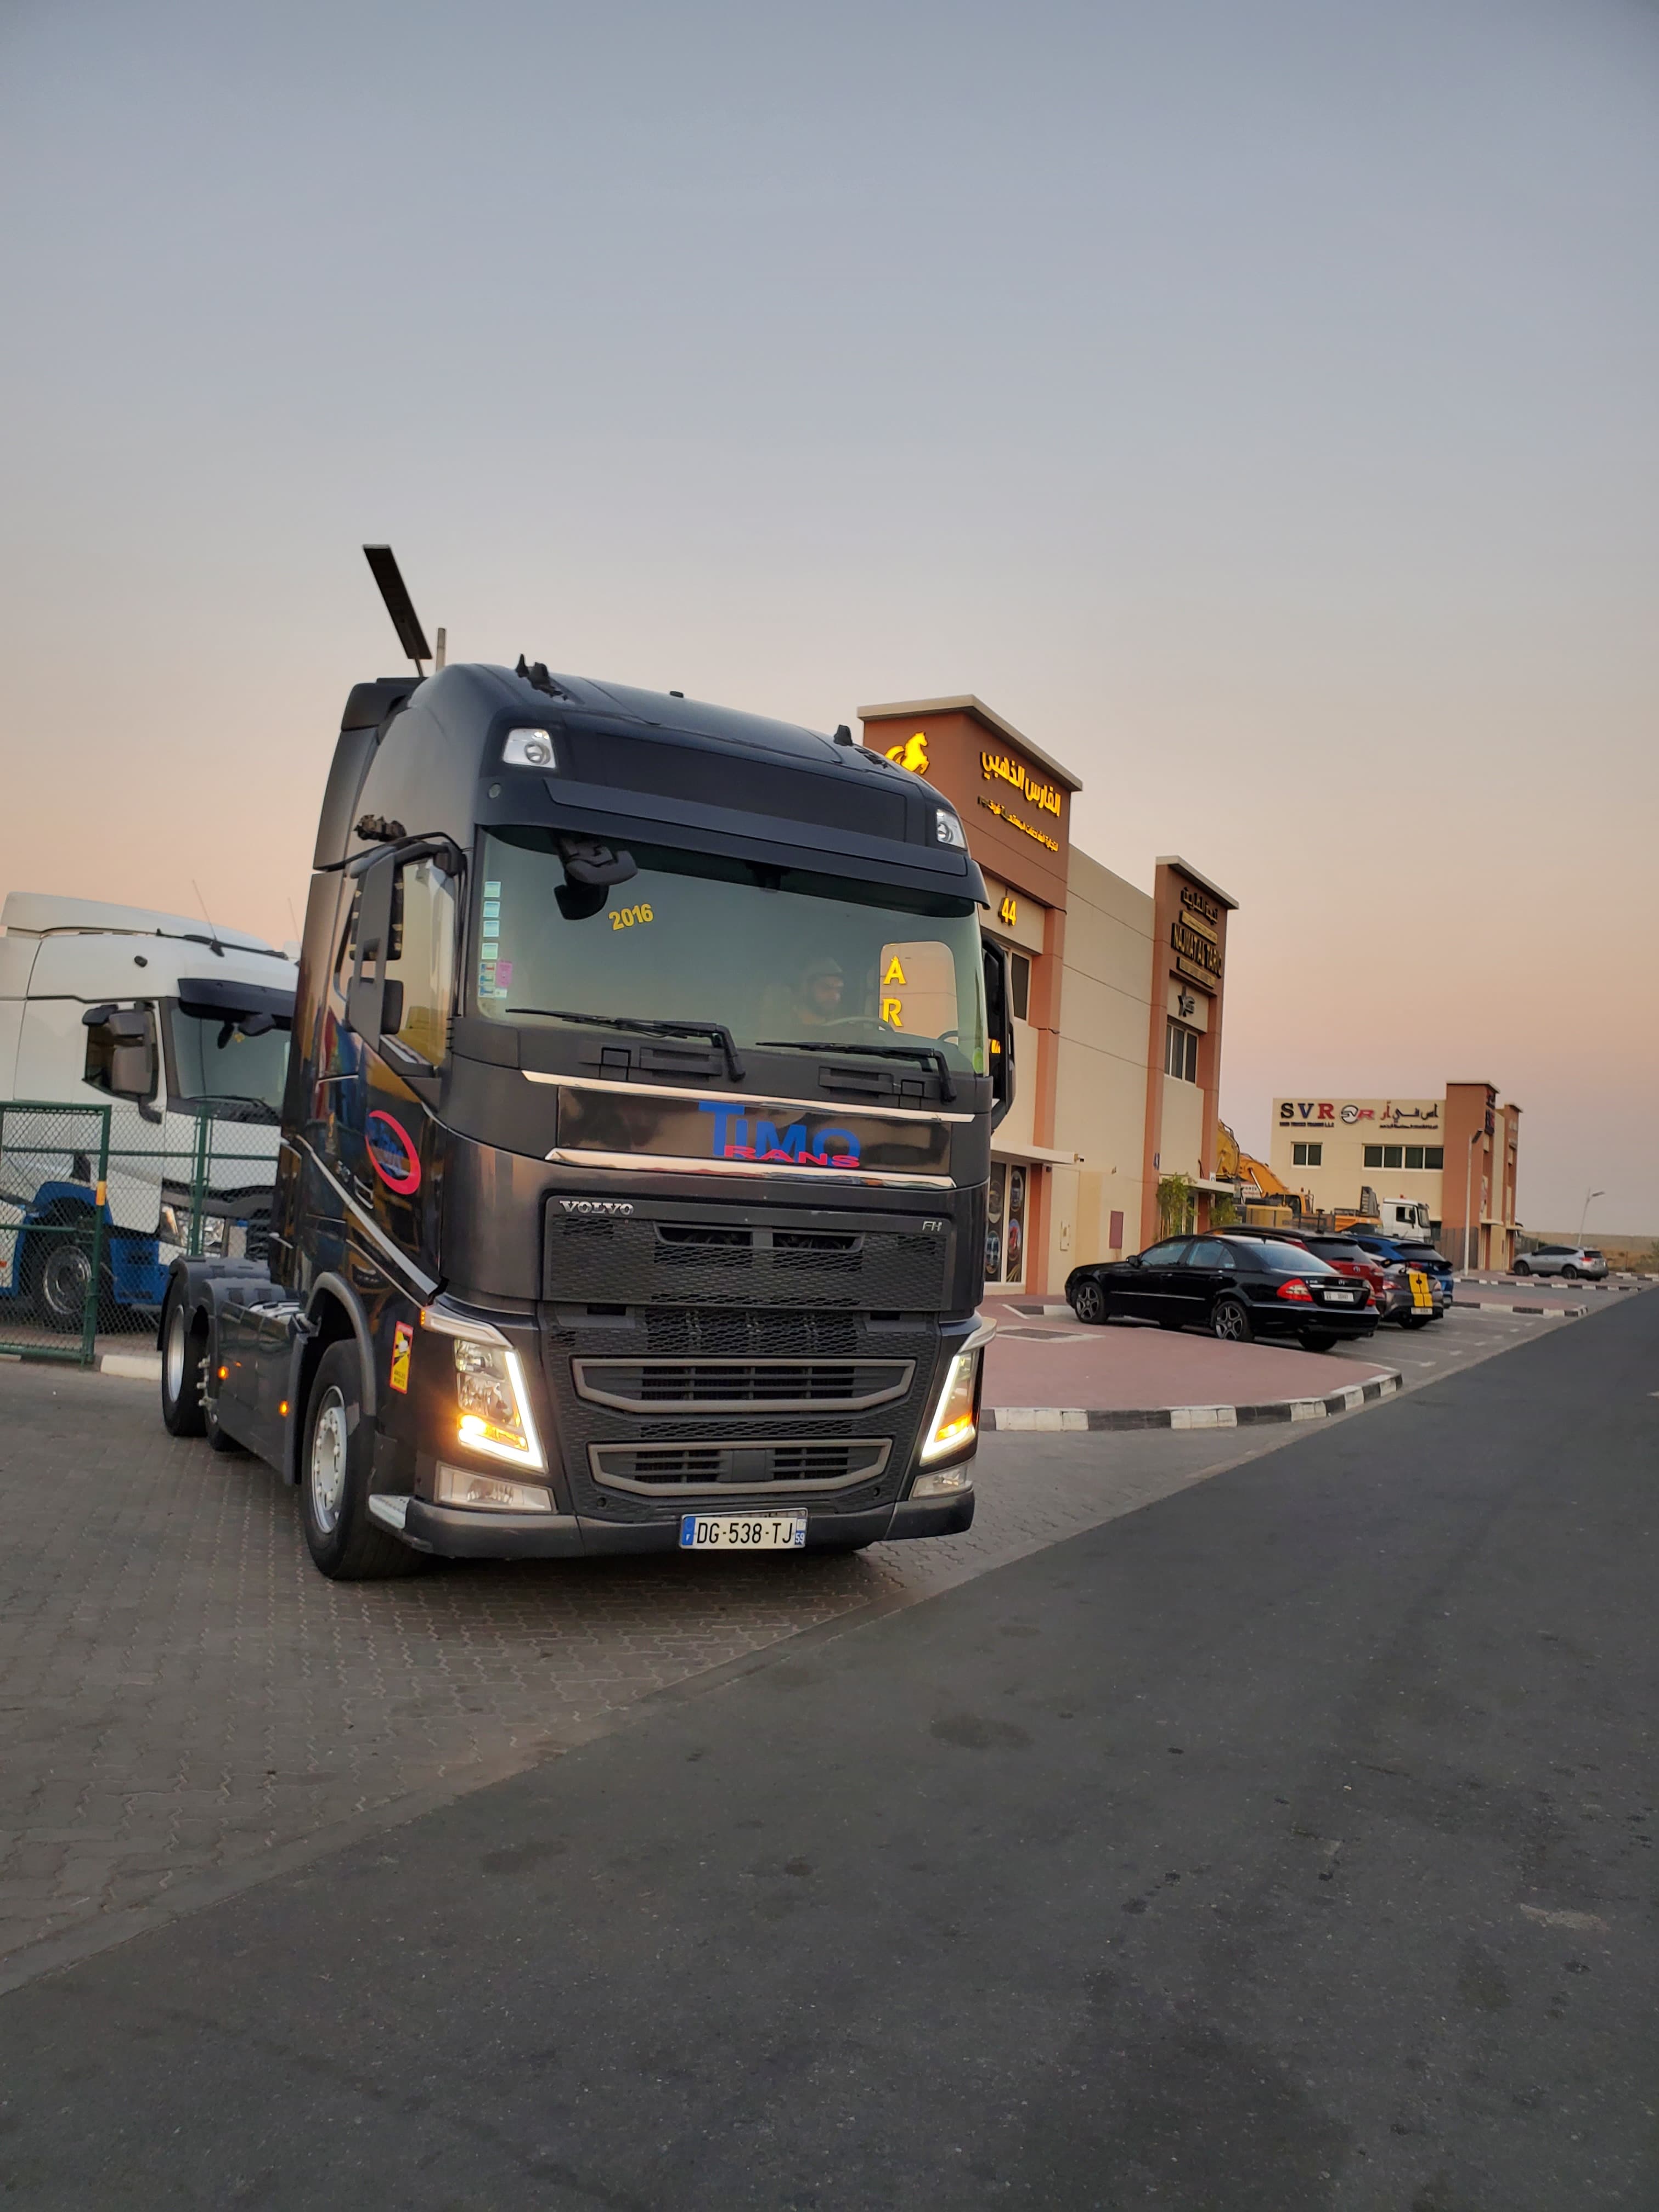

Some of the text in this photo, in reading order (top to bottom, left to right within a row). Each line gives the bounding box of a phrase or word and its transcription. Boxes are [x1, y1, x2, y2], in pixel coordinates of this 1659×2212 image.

[981, 752, 1025, 790] الذهبي
[1024, 777, 1060, 817] الفارس
[609, 904, 653, 930] 2016
[1001, 897, 1016, 926] 44
[1280, 1103, 1335, 1120] SVR
[724, 1145, 860, 1167] RANS
[560, 1200, 634, 1215] VOLVO
[922, 1221, 942, 1231] FH
[697, 1523, 792, 1544] DG-538-TJ
[795, 1532, 805, 1544] 59
